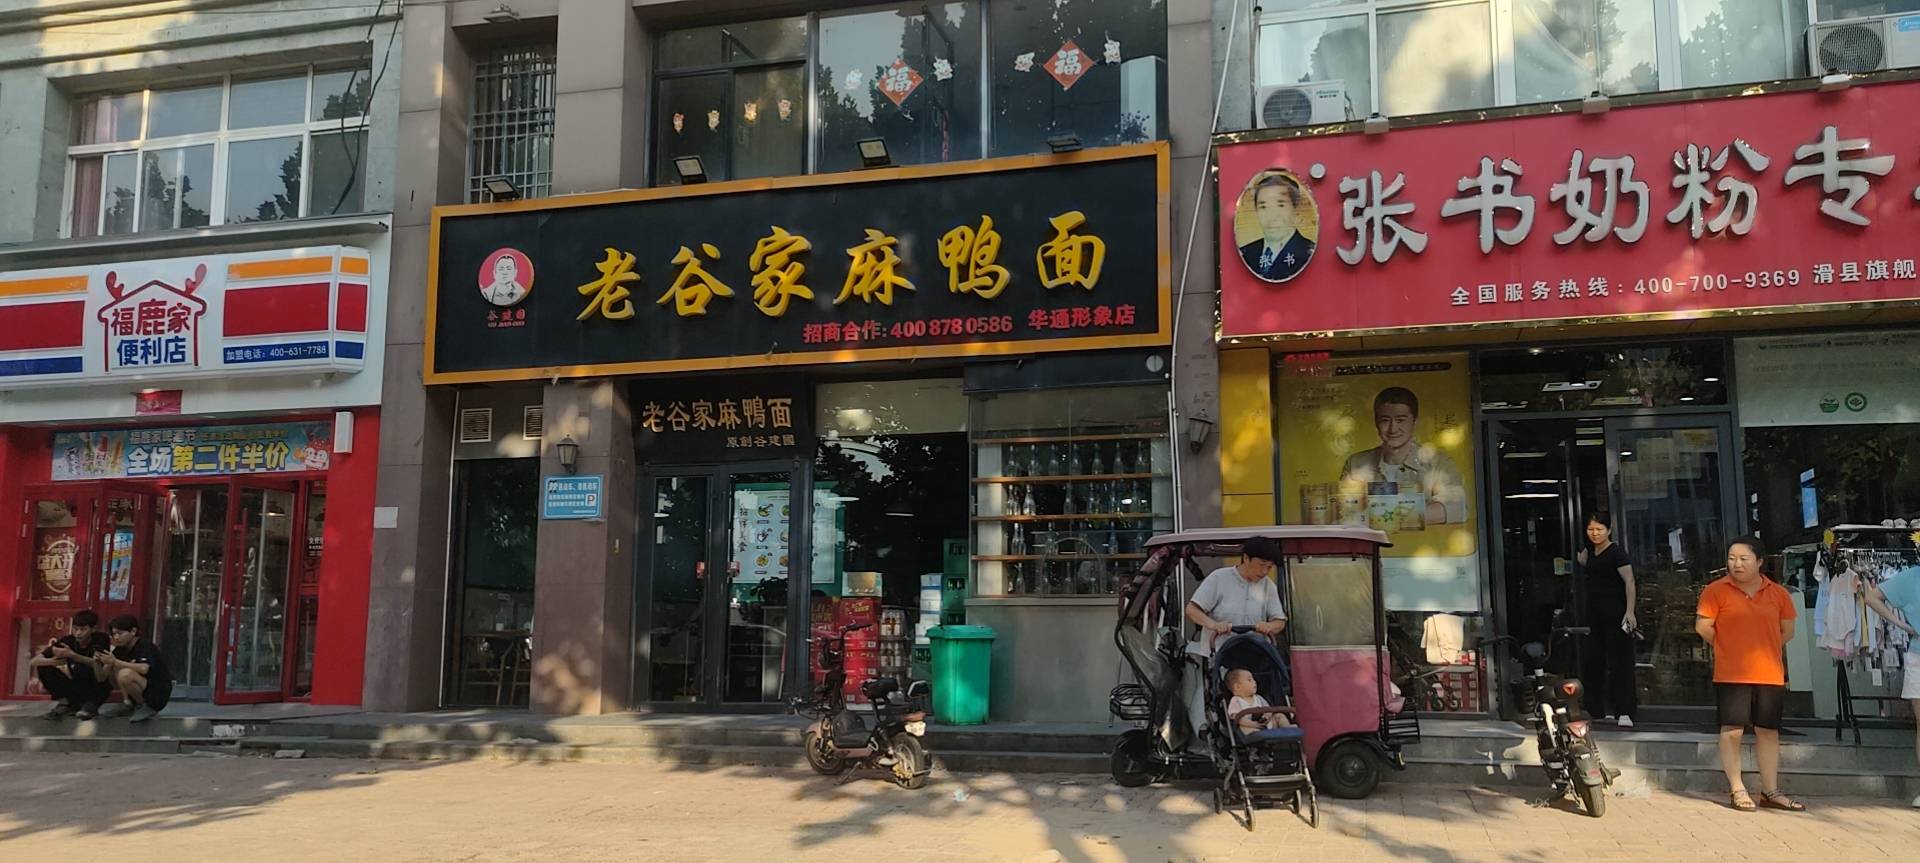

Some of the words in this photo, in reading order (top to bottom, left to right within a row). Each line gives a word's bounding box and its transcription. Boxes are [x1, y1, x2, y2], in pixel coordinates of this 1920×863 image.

[1054, 49, 1082, 75] 福
[886, 65, 912, 92] 福
[1336, 126, 1920, 265] 张书奶粉专
[576, 210, 1106, 320] 老谷家麻鸭面
[1260, 252, 1295, 268] 张书
[1813, 259, 1917, 284] 滑县旗舰
[111, 298, 191, 336] 福鹿家
[1028, 304, 1136, 331] 华通形象店
[117, 336, 186, 366] 便利店
[128, 442, 289, 474] 全场第二件半价
